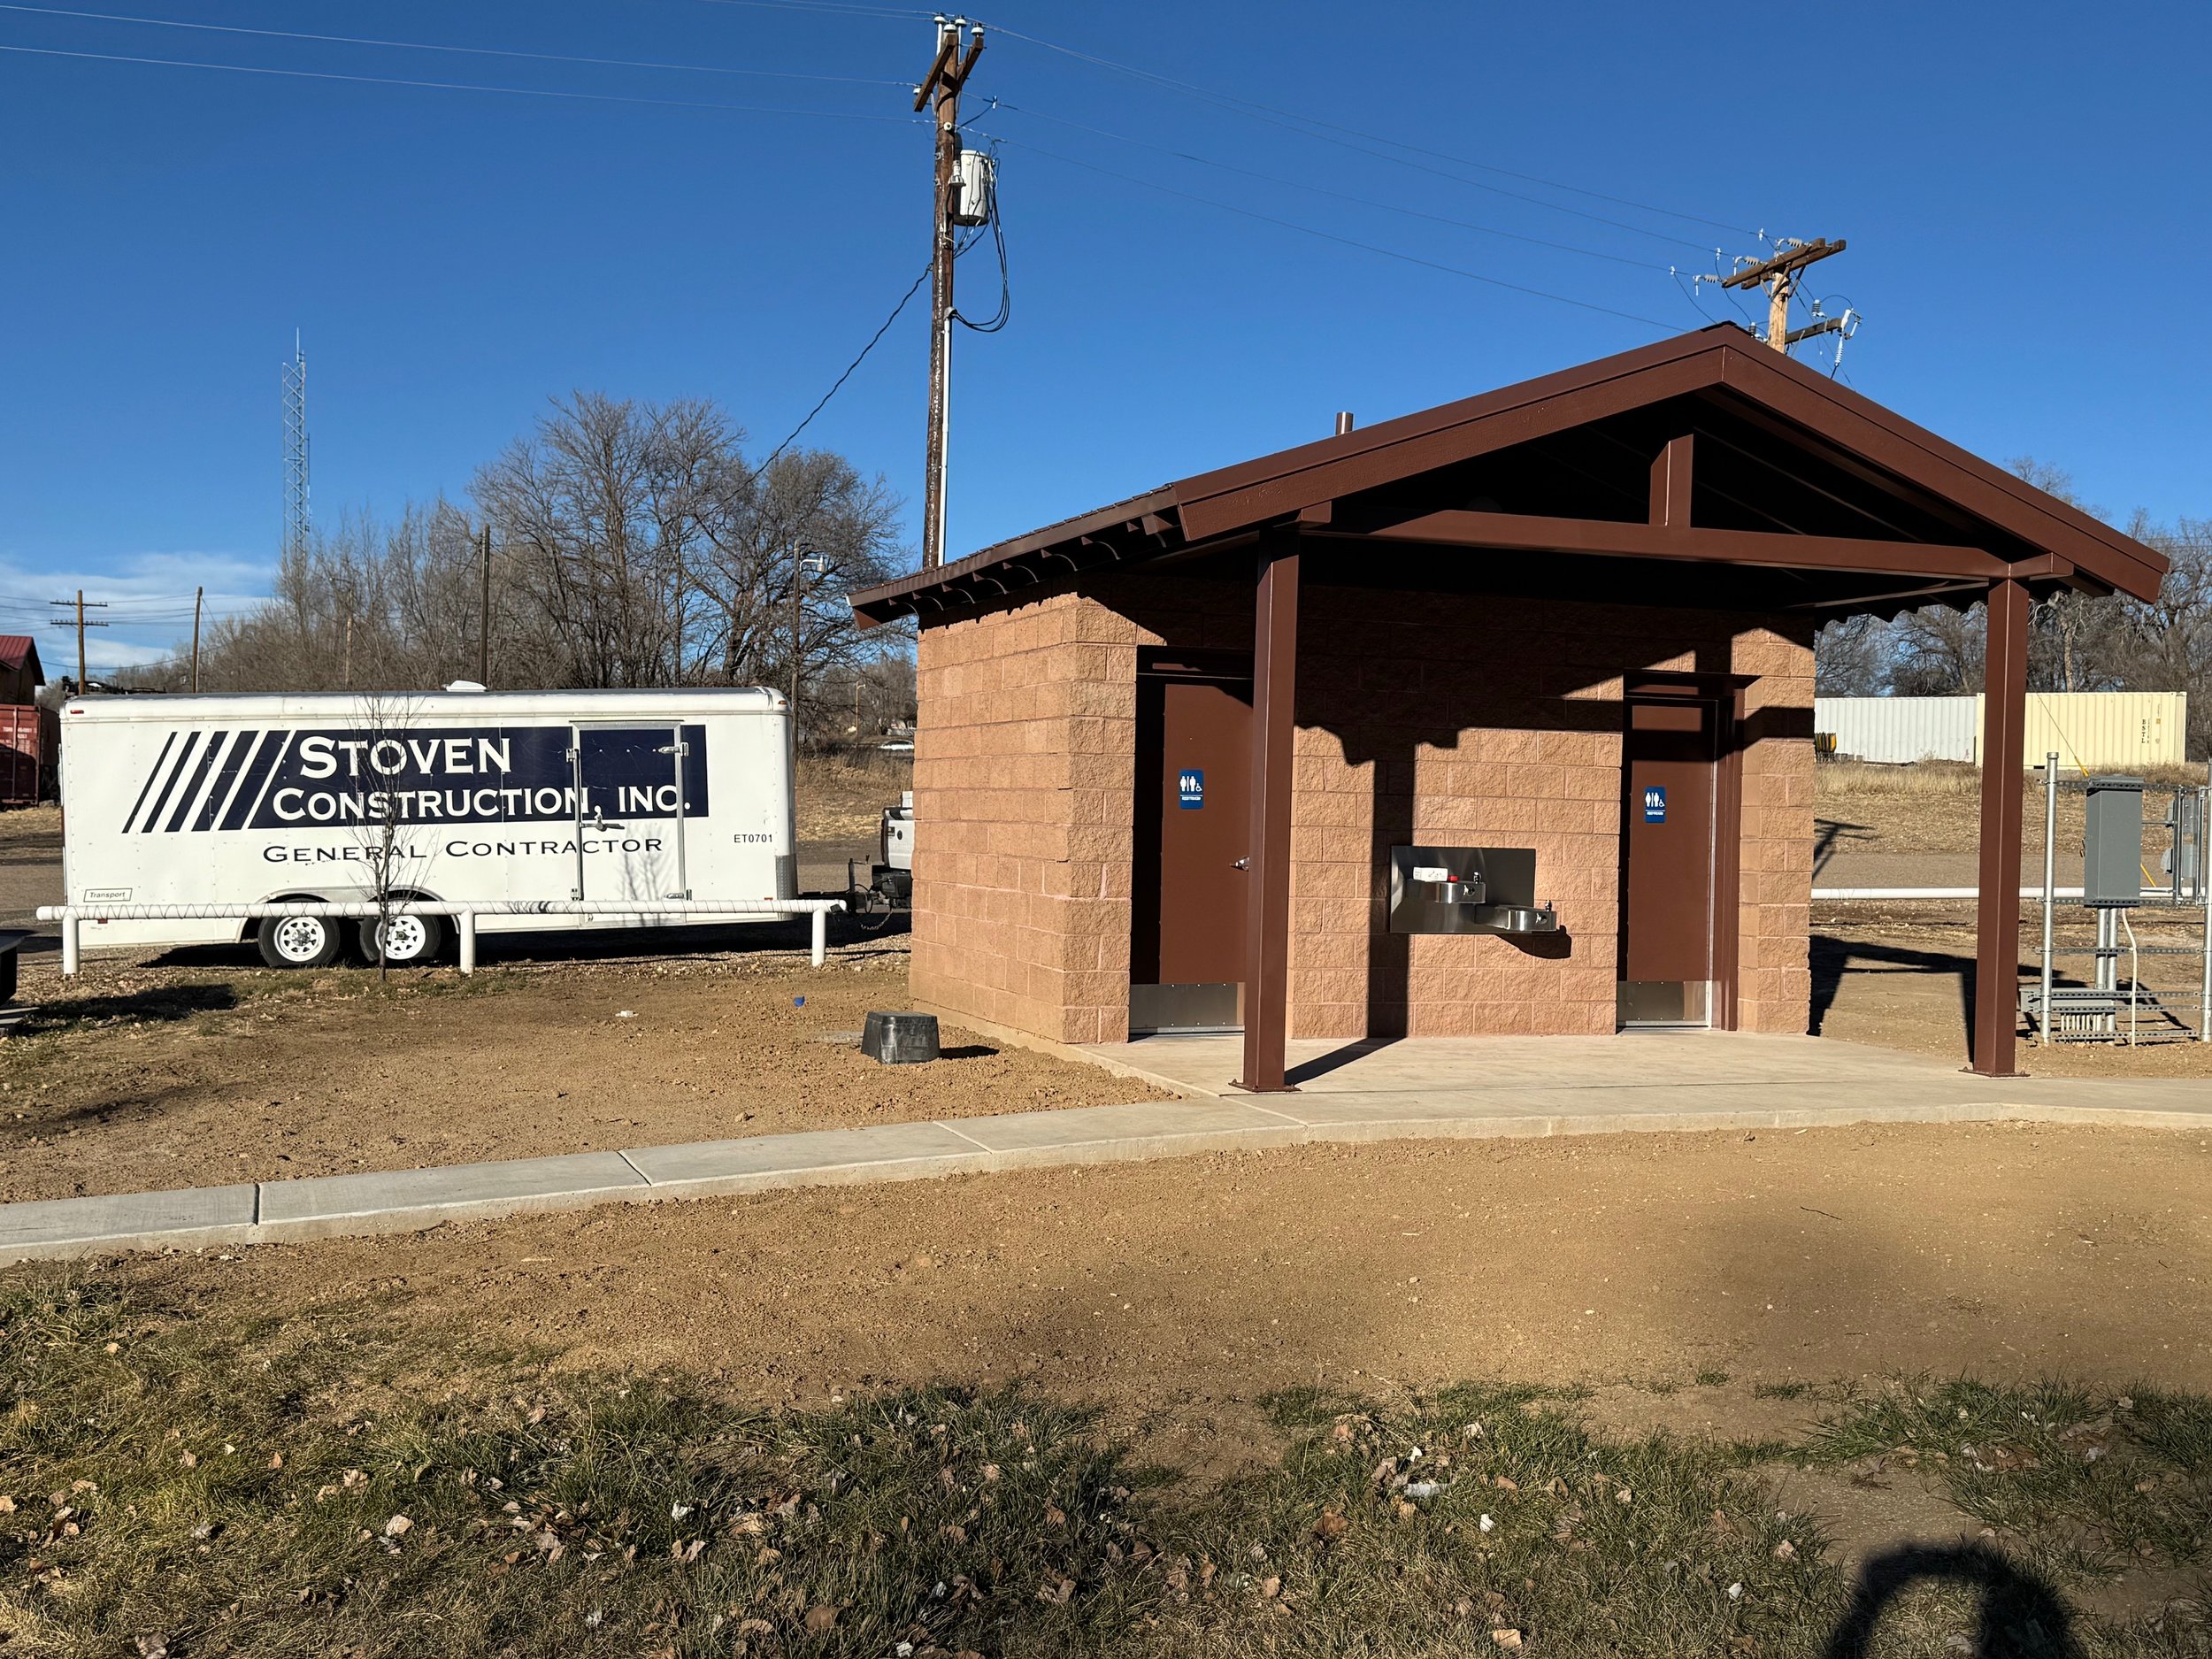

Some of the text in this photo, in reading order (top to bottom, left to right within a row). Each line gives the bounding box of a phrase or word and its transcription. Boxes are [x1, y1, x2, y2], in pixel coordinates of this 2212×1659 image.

[299, 736, 511, 779] STOVEN
[618, 785, 691, 812] INC.
[733, 833, 772, 843] ET0701
[263, 839, 663, 863] GENERAL CONTRACTOR
[90, 891, 126, 900] Transport
